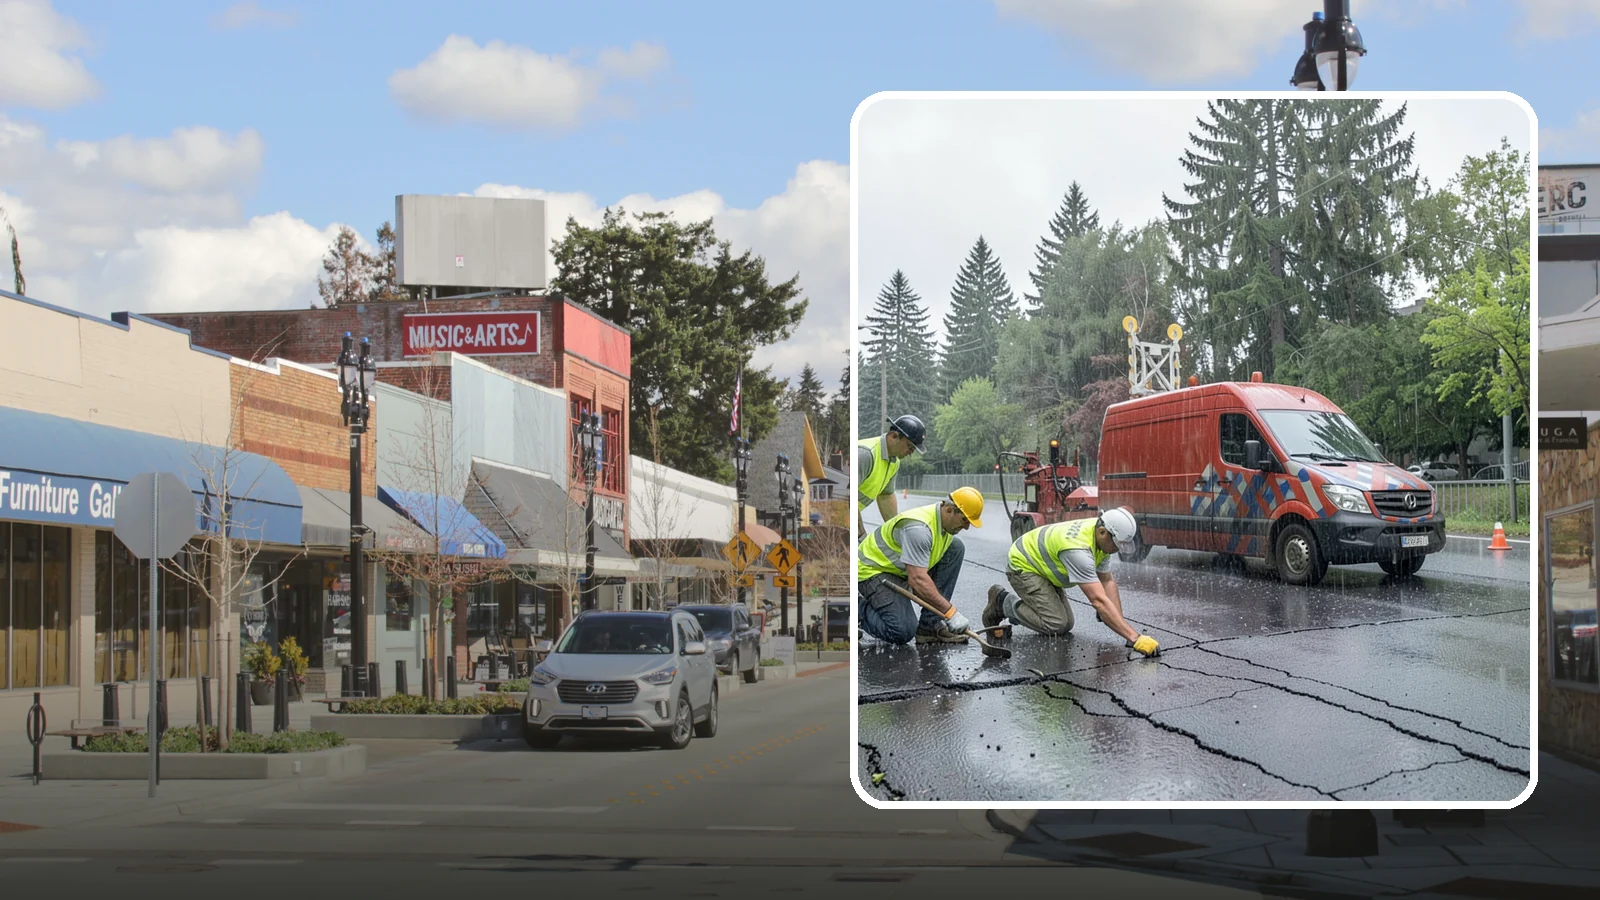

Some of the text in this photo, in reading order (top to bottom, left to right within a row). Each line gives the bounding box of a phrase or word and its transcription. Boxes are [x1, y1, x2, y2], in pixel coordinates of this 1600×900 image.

[408, 322, 520, 348] MUSIC&ARTS
[1540, 427, 1577, 436] UGA
[0, 471, 79, 515] Furniture
[454, 563, 480, 574] SUSHI
